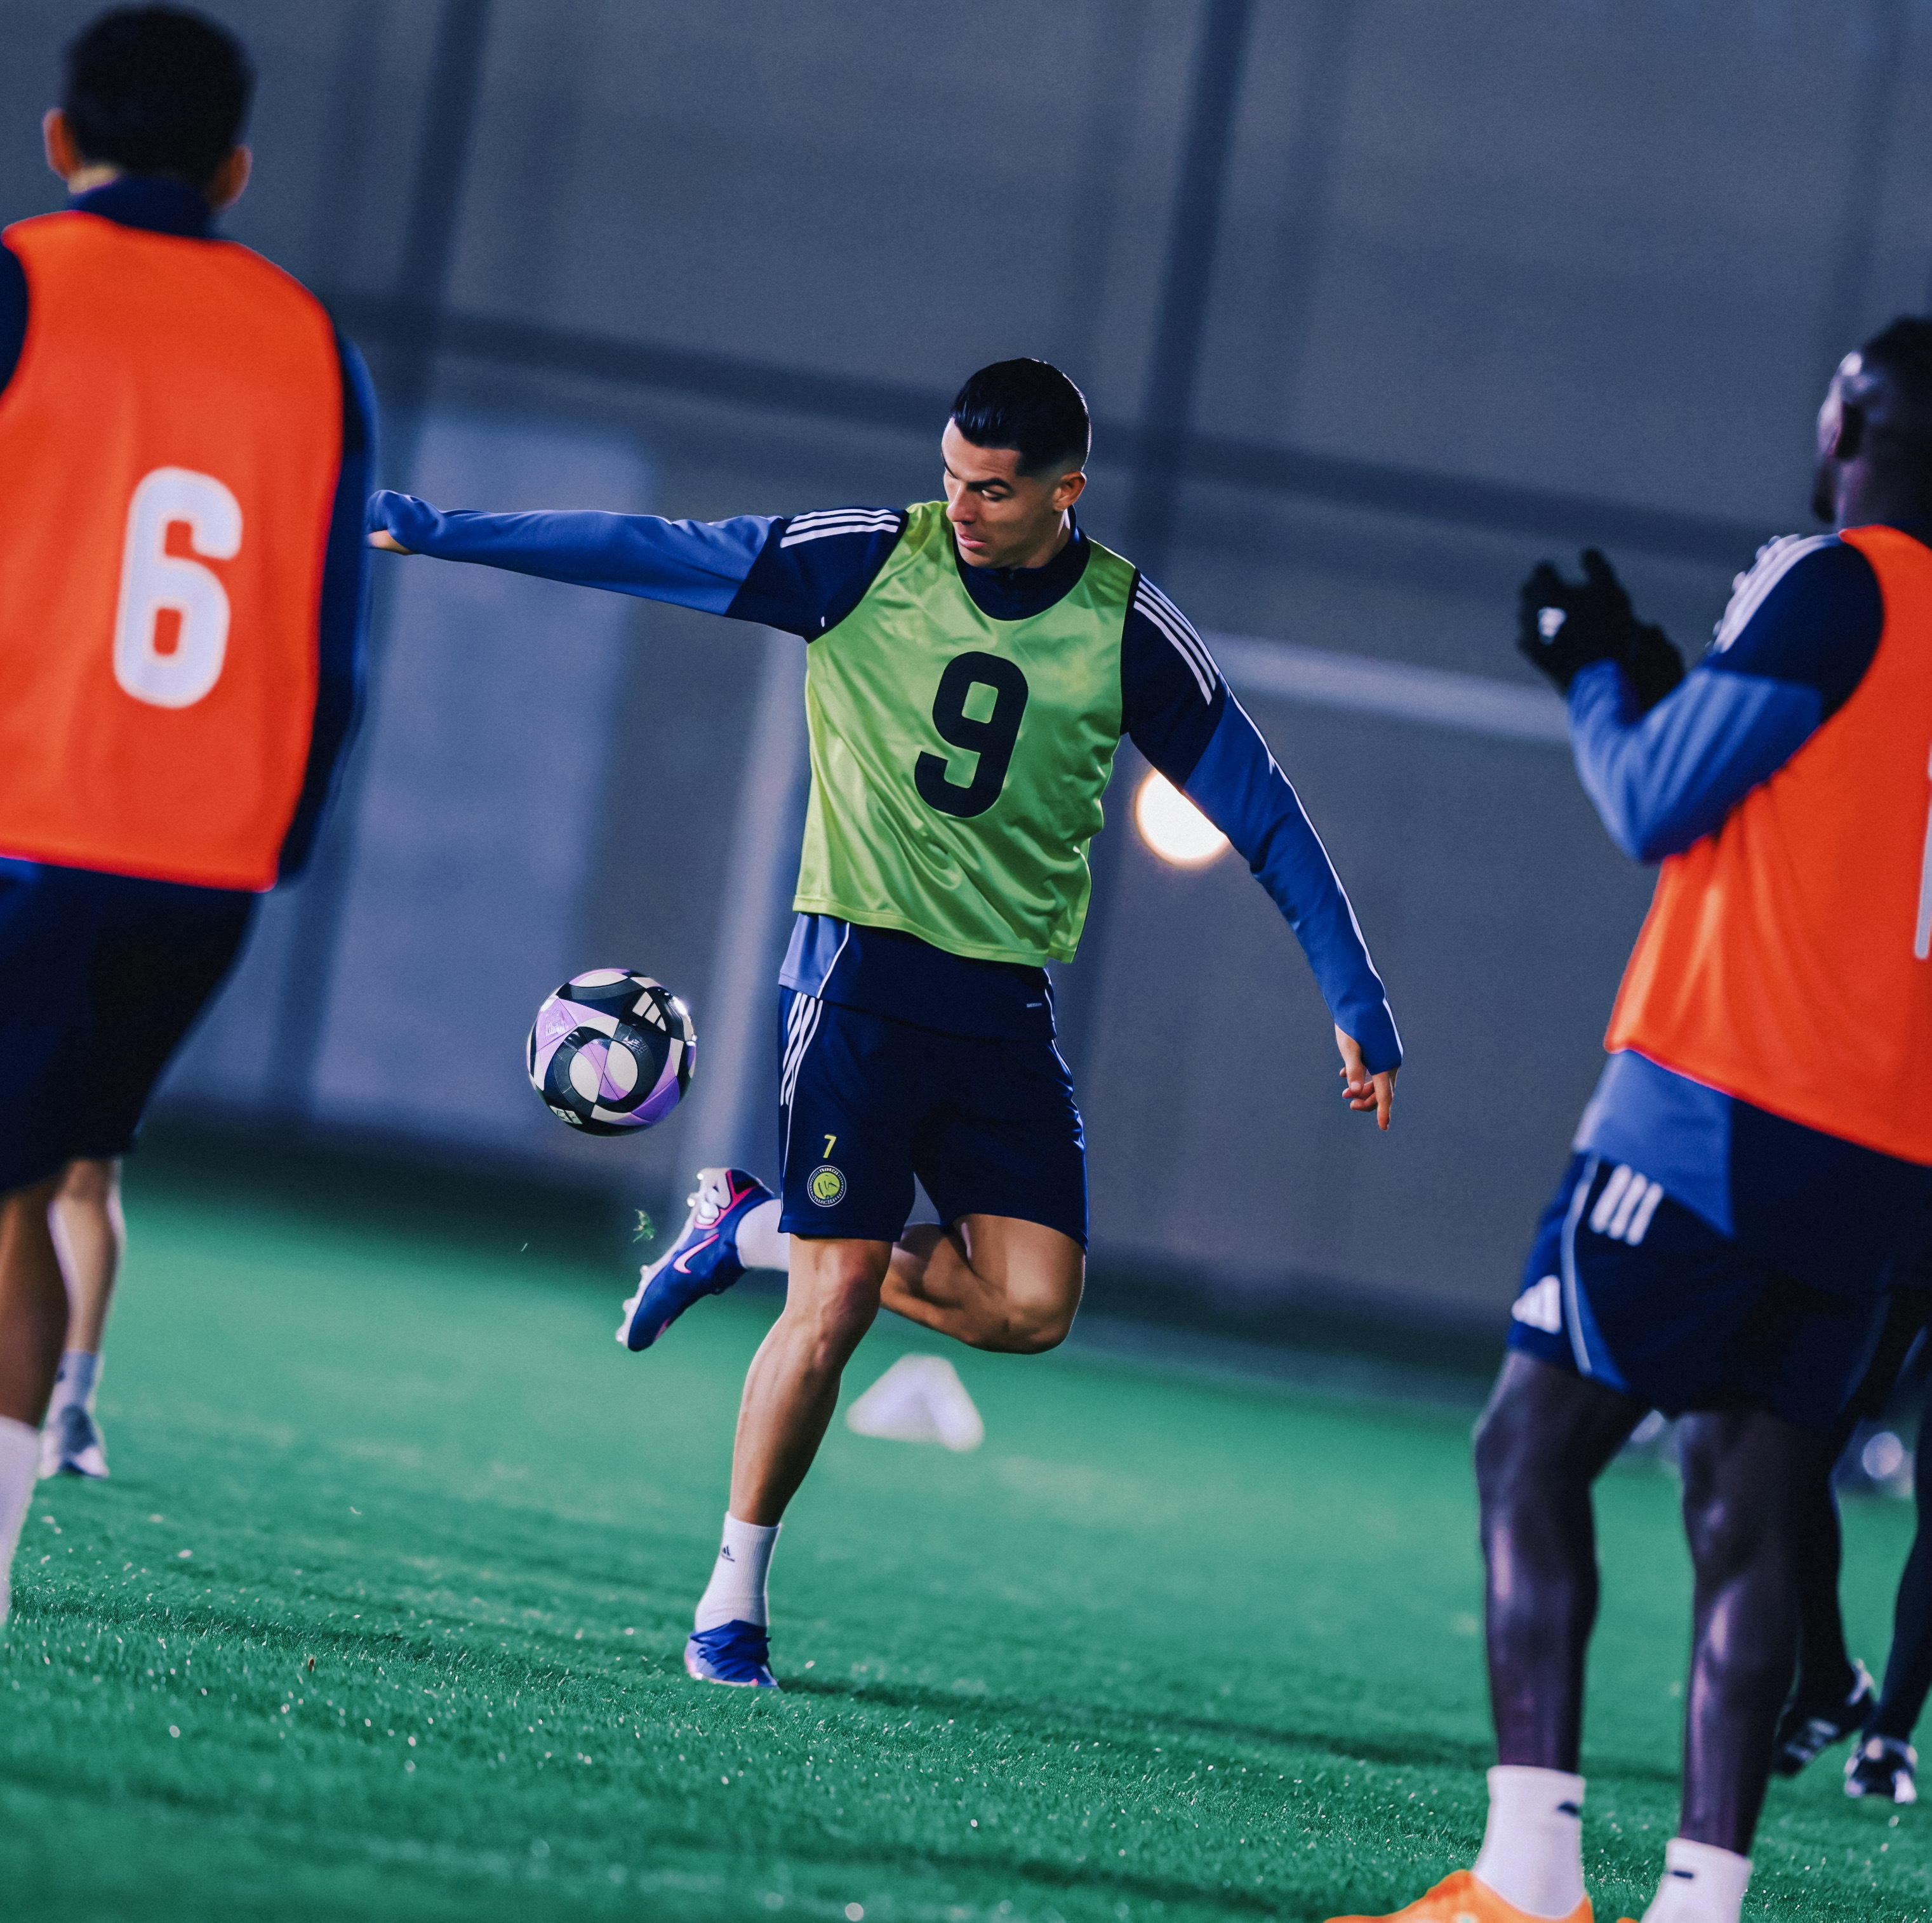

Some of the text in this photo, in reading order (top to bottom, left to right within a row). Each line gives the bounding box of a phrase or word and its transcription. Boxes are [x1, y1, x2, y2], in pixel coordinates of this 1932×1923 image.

[113, 466, 243, 709] 6
[914, 651, 1029, 818] 9
[823, 1134, 837, 1159] 7
